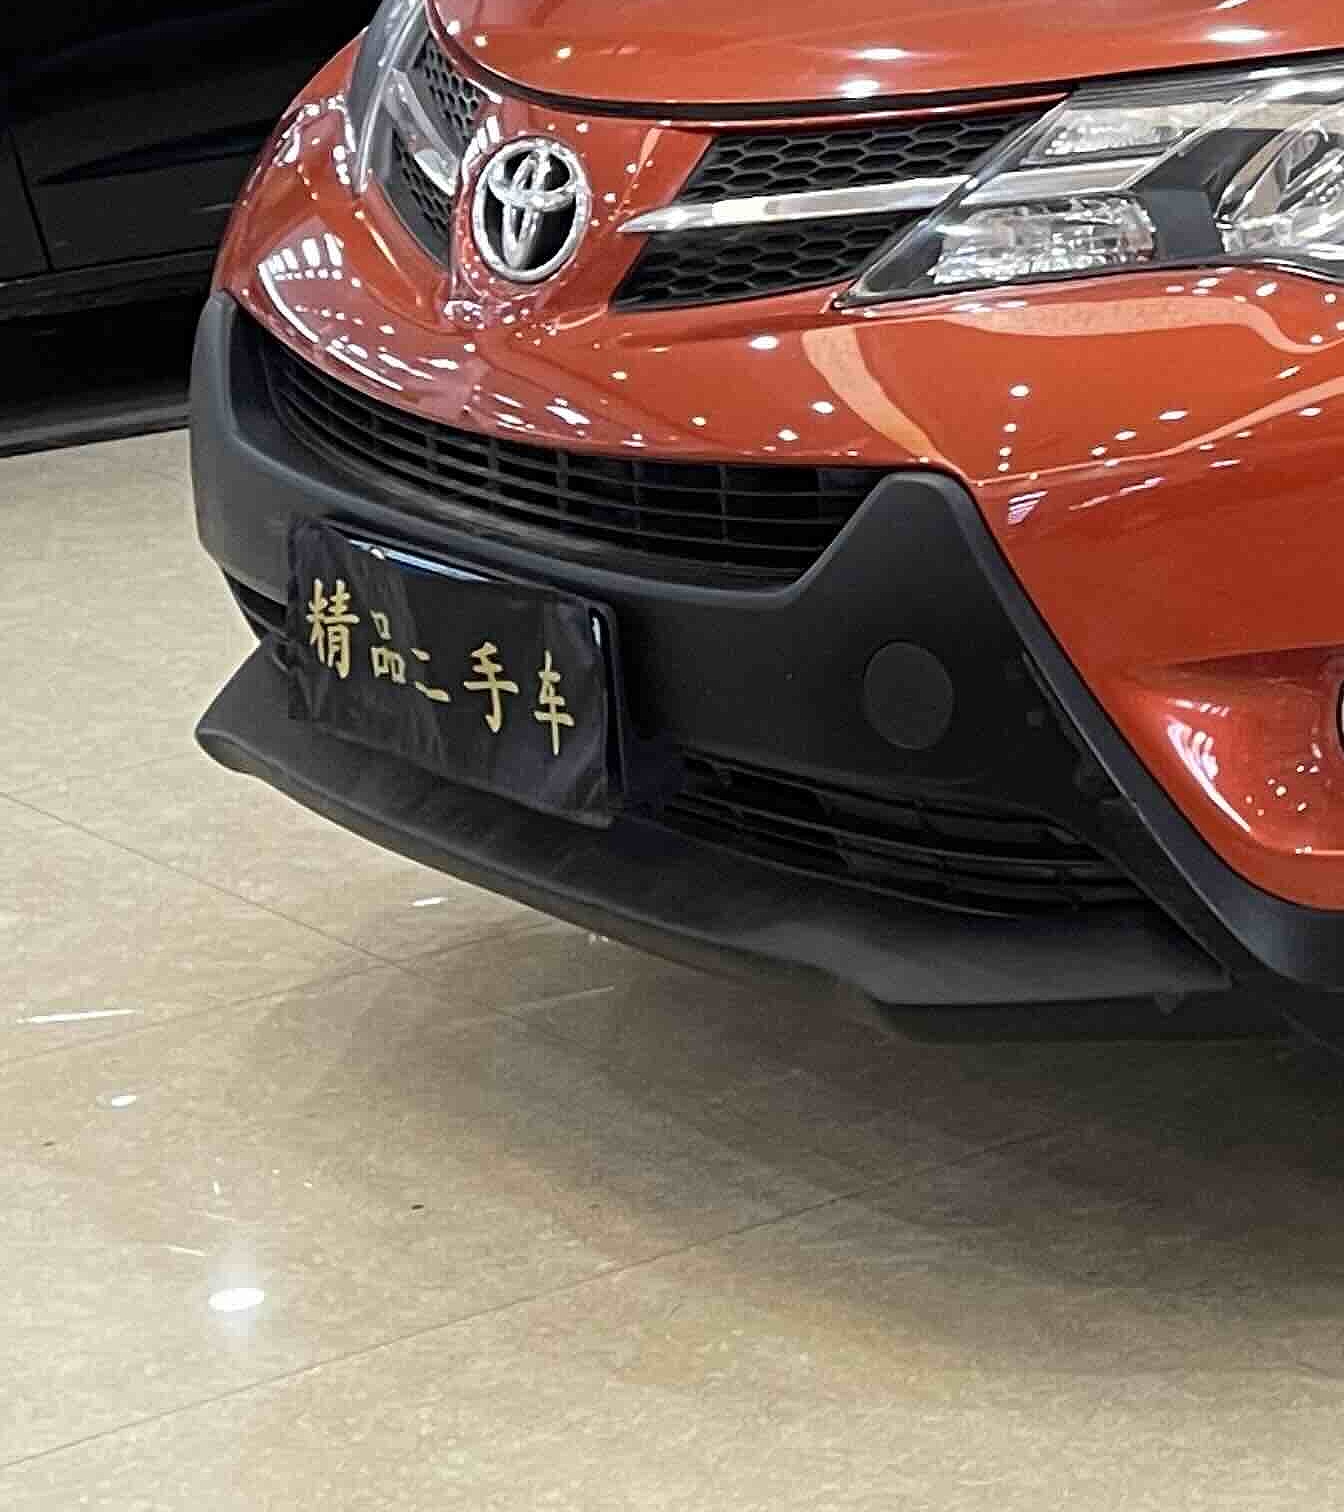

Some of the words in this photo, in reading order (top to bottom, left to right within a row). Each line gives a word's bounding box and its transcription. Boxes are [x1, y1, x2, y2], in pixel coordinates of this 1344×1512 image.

[305, 577, 577, 757] 精品二手车
